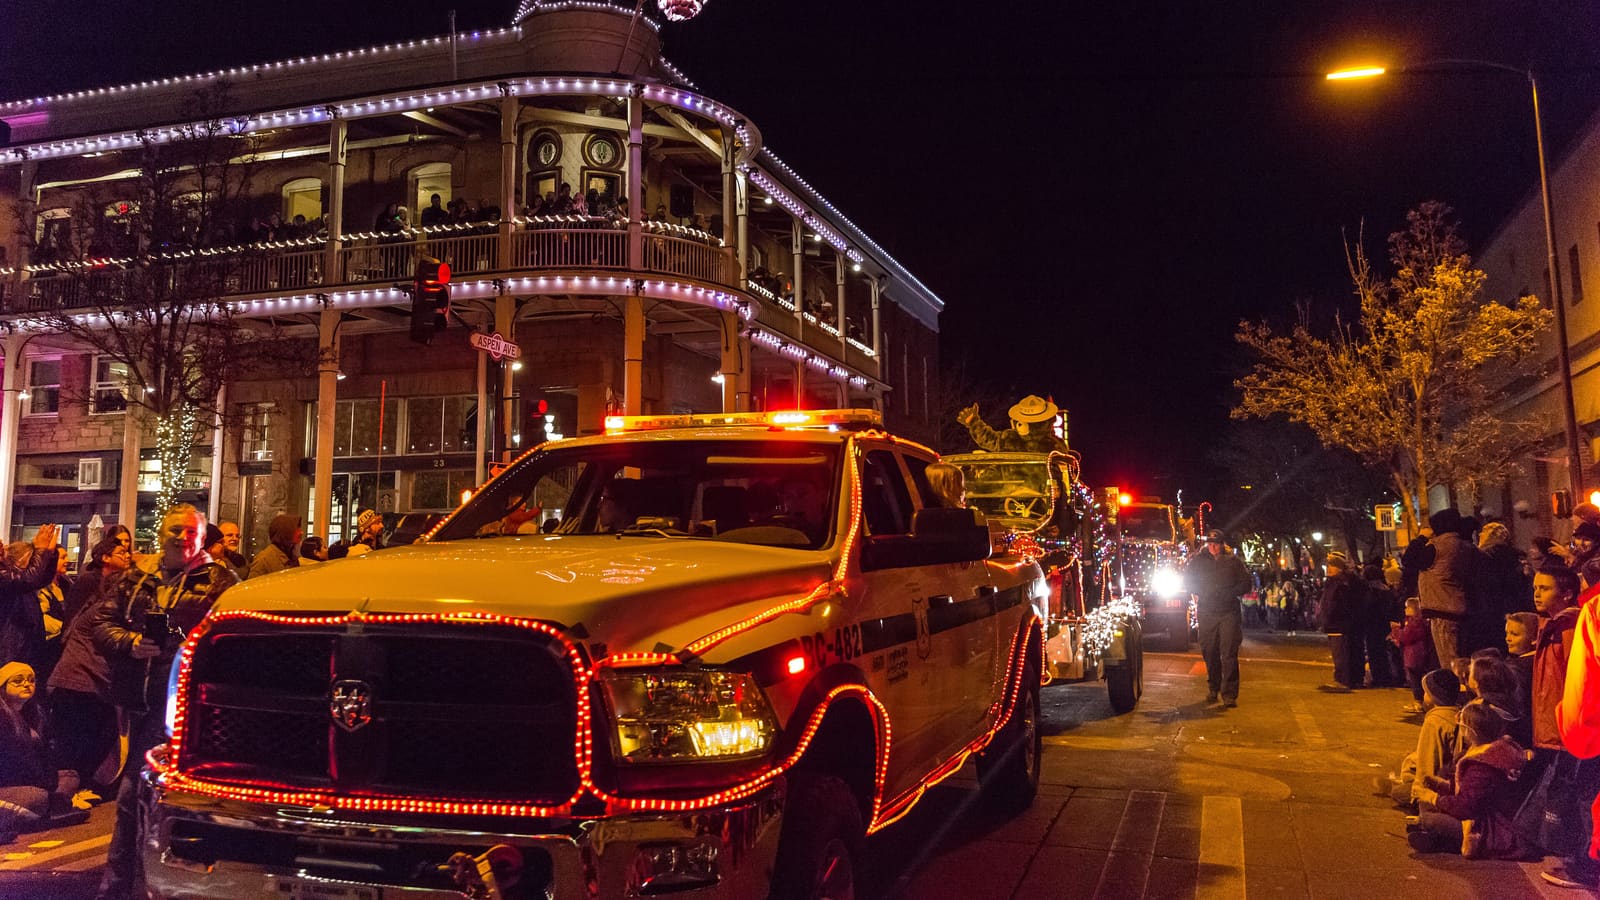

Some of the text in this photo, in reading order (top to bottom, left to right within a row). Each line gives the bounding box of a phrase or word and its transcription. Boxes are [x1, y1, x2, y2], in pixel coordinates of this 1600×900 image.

[477, 335, 517, 356] ASPEN AVE
[433, 459, 445, 468] 23
